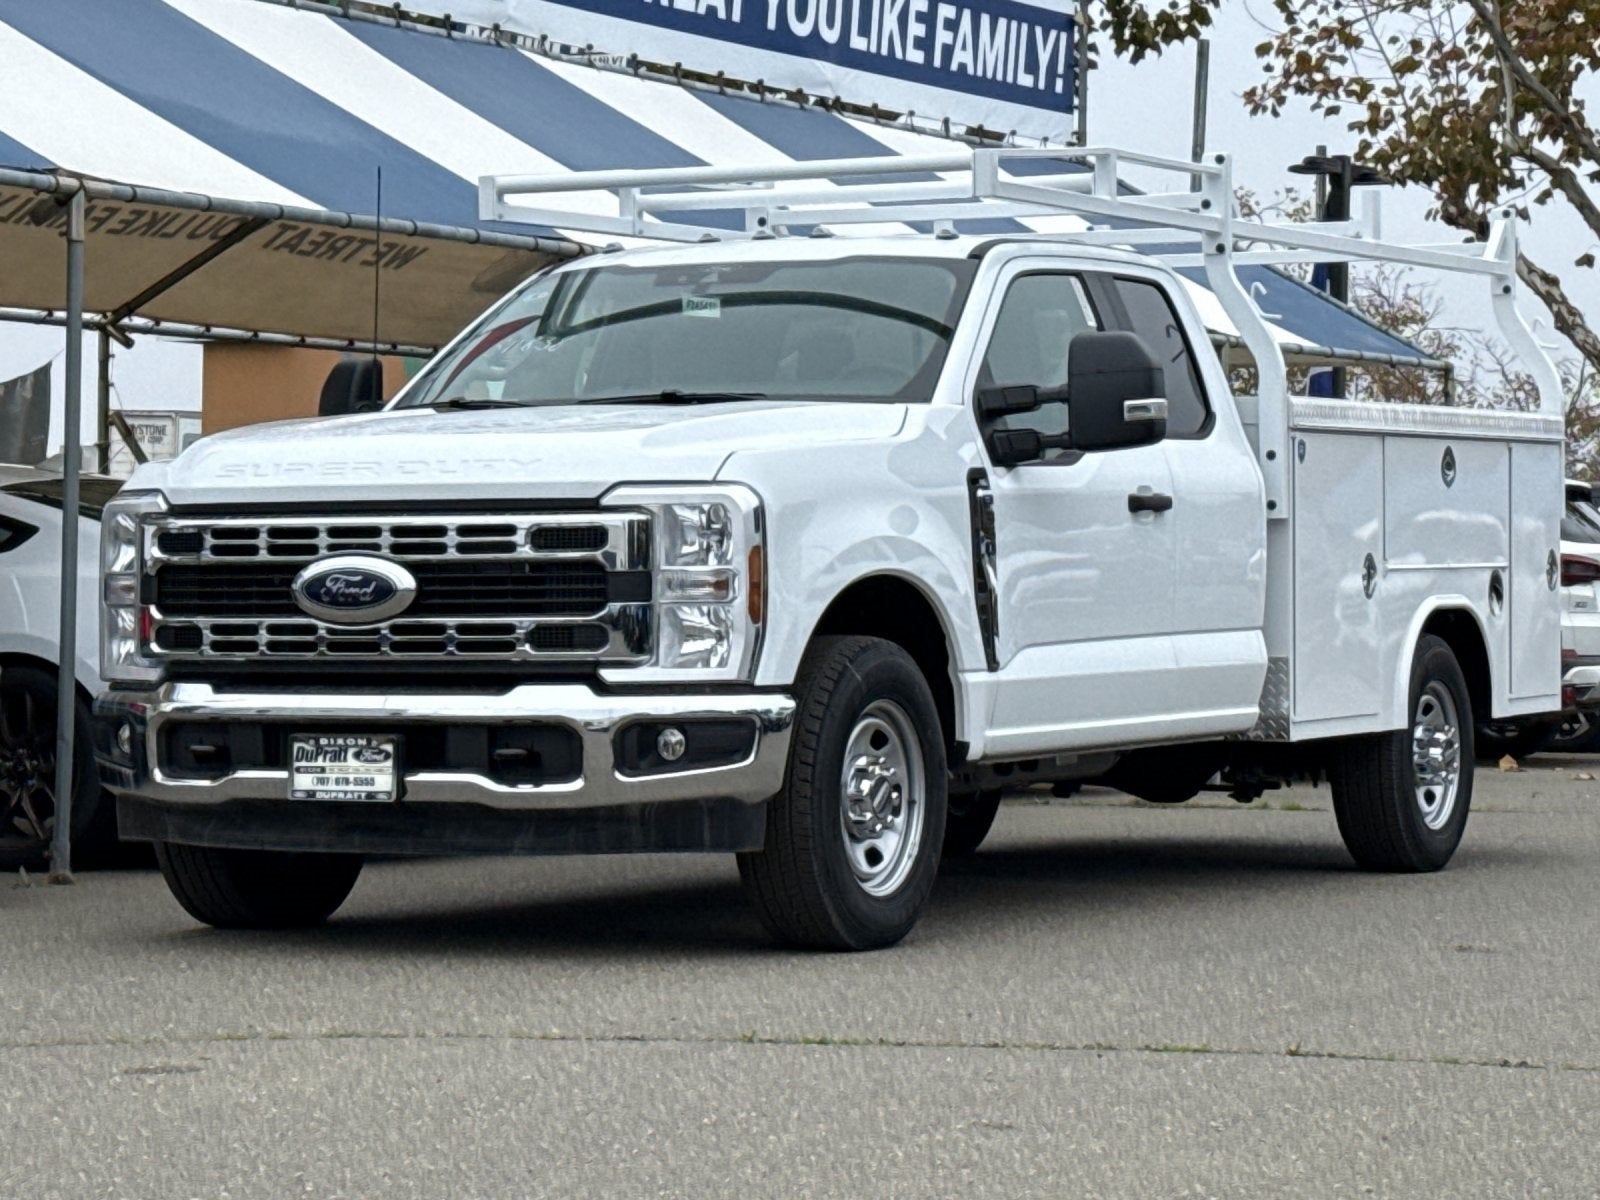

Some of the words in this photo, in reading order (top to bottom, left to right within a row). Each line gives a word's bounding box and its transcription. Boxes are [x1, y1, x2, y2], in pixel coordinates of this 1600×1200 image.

[849, 0, 928, 65] LIKE
[933, 2, 1067, 94] FAMILY!
[215, 460, 384, 478] SUPER
[396, 457, 543, 475] DUTY
[319, 573, 377, 601] Ford
[319, 737, 367, 746] DIXON
